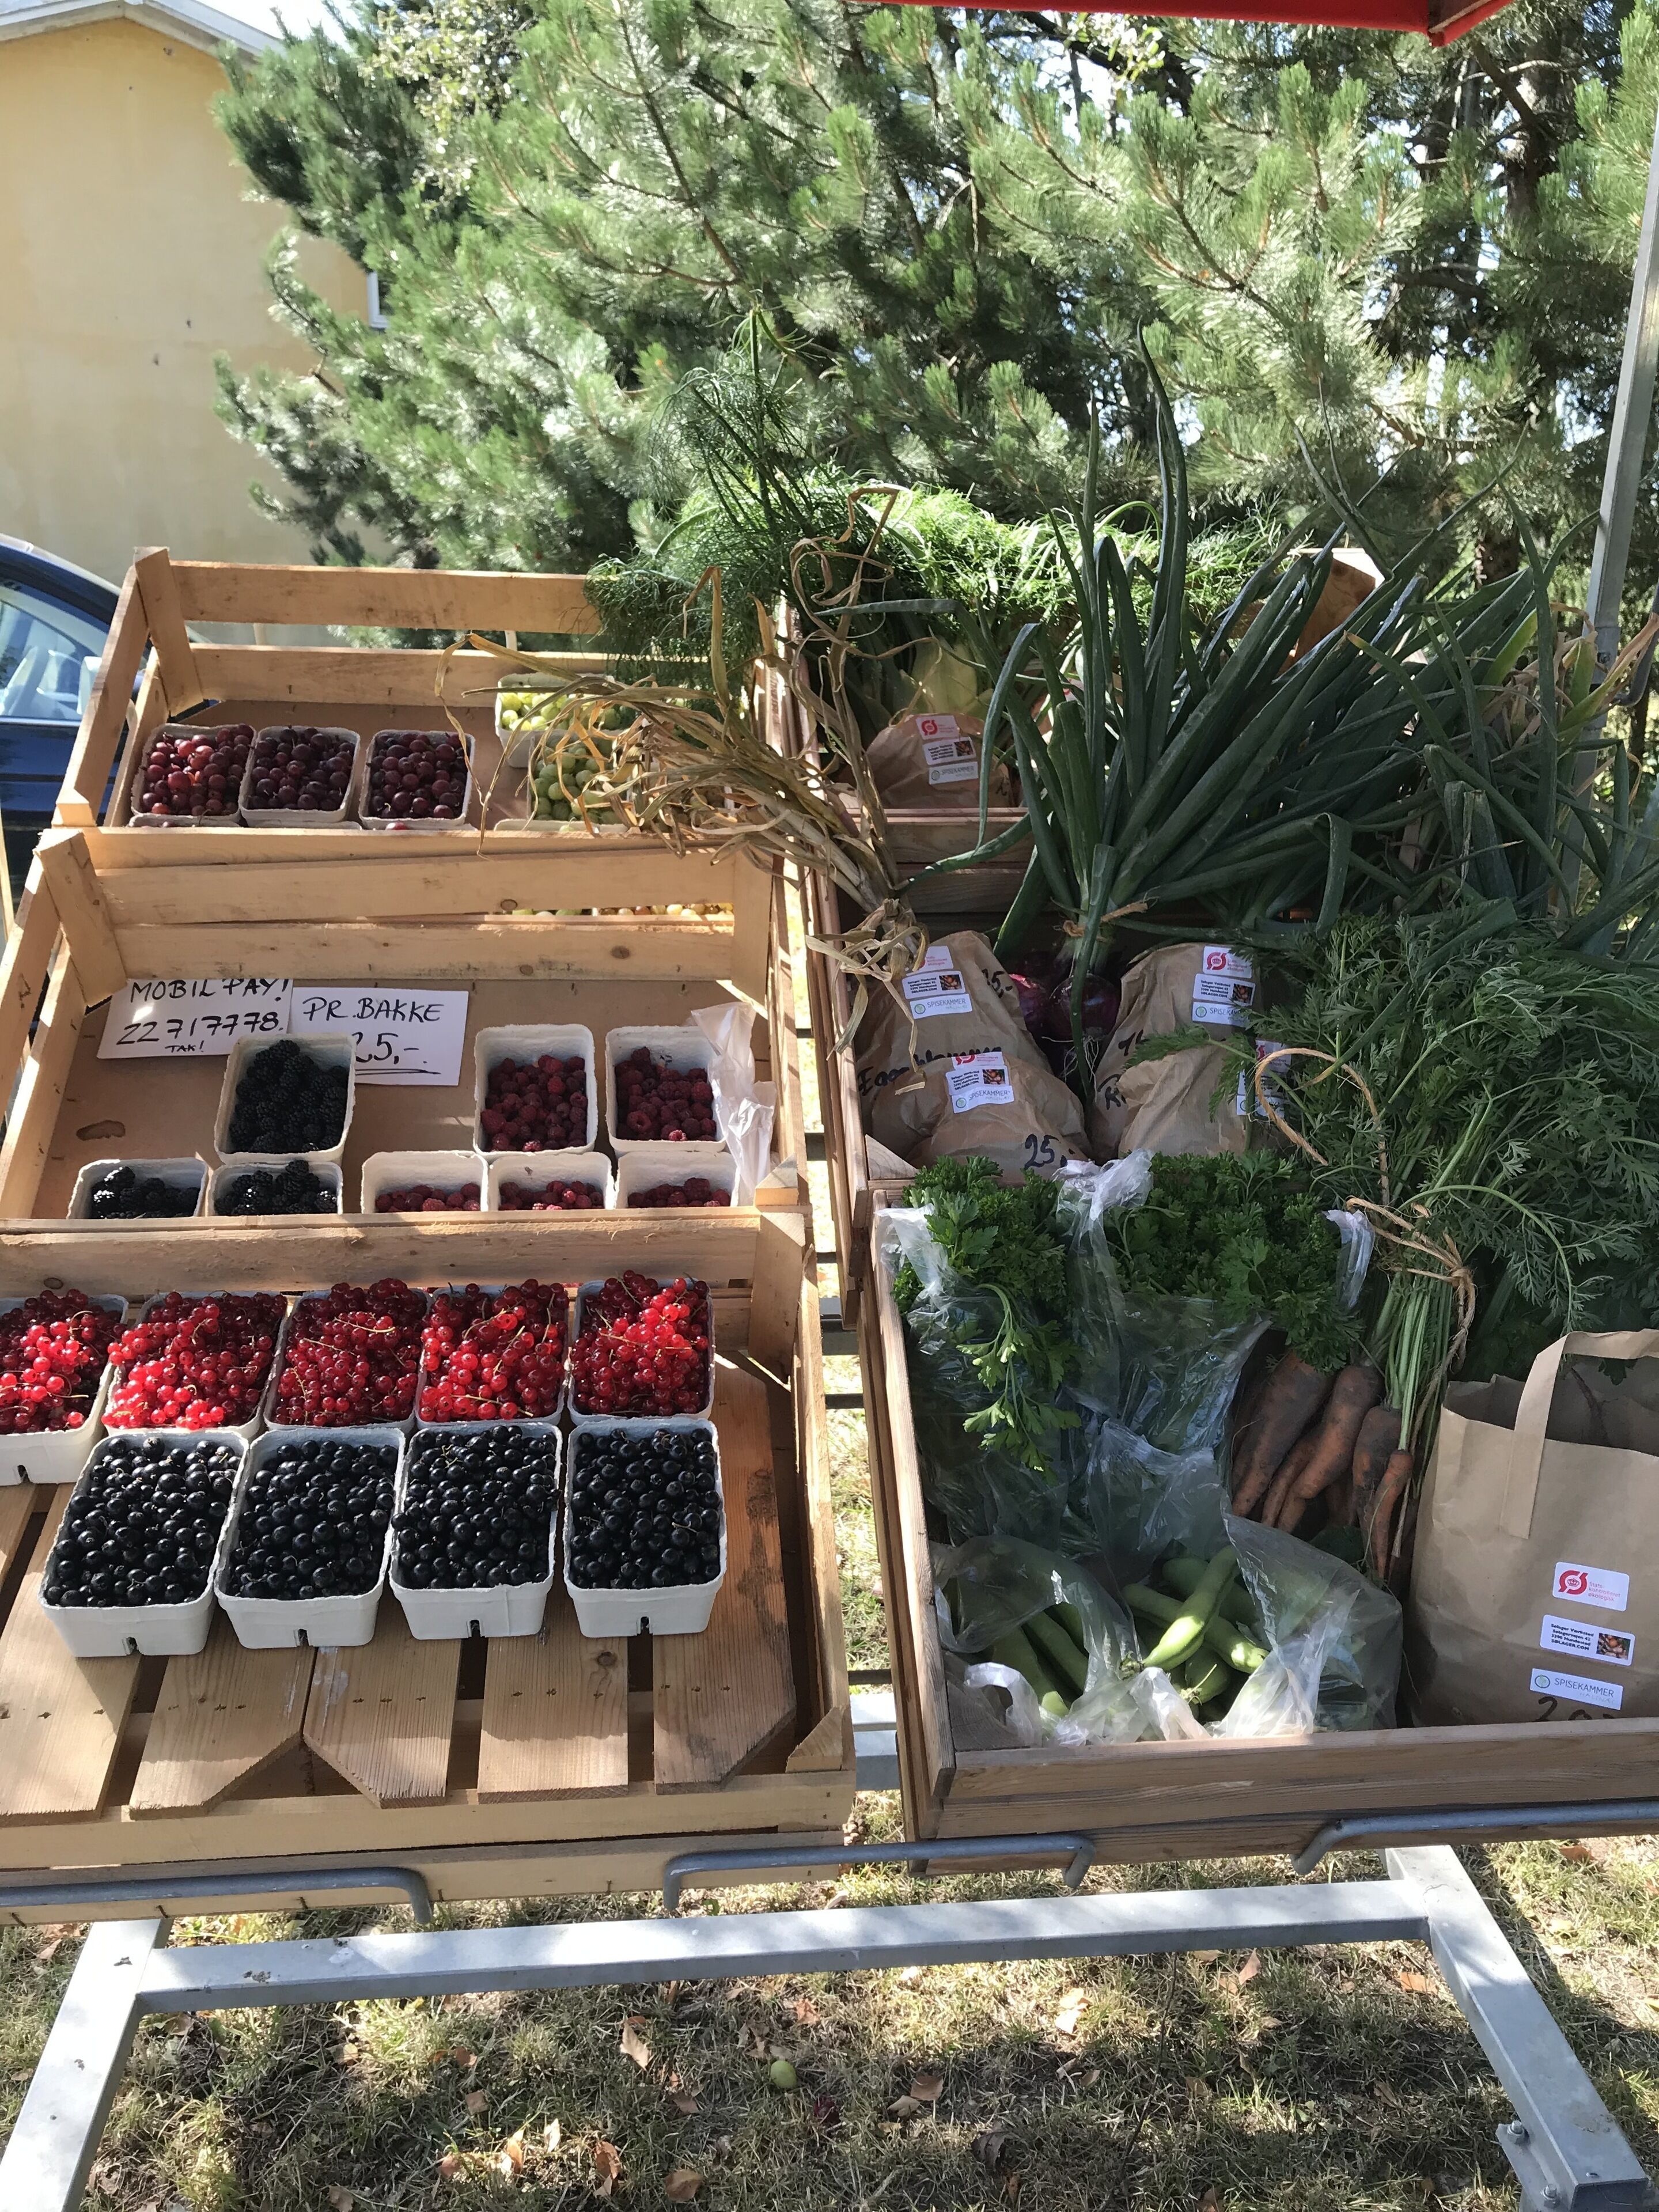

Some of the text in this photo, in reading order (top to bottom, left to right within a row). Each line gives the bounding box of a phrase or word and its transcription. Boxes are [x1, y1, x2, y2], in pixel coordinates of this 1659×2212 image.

[130, 979, 289, 1003] MOBIL PAY!
[927, 998, 967, 1008] SPISEKAMMER
[165, 1040, 204, 1053] TAK!
[1554, 1677, 1614, 1698] SPISEKAMMER
